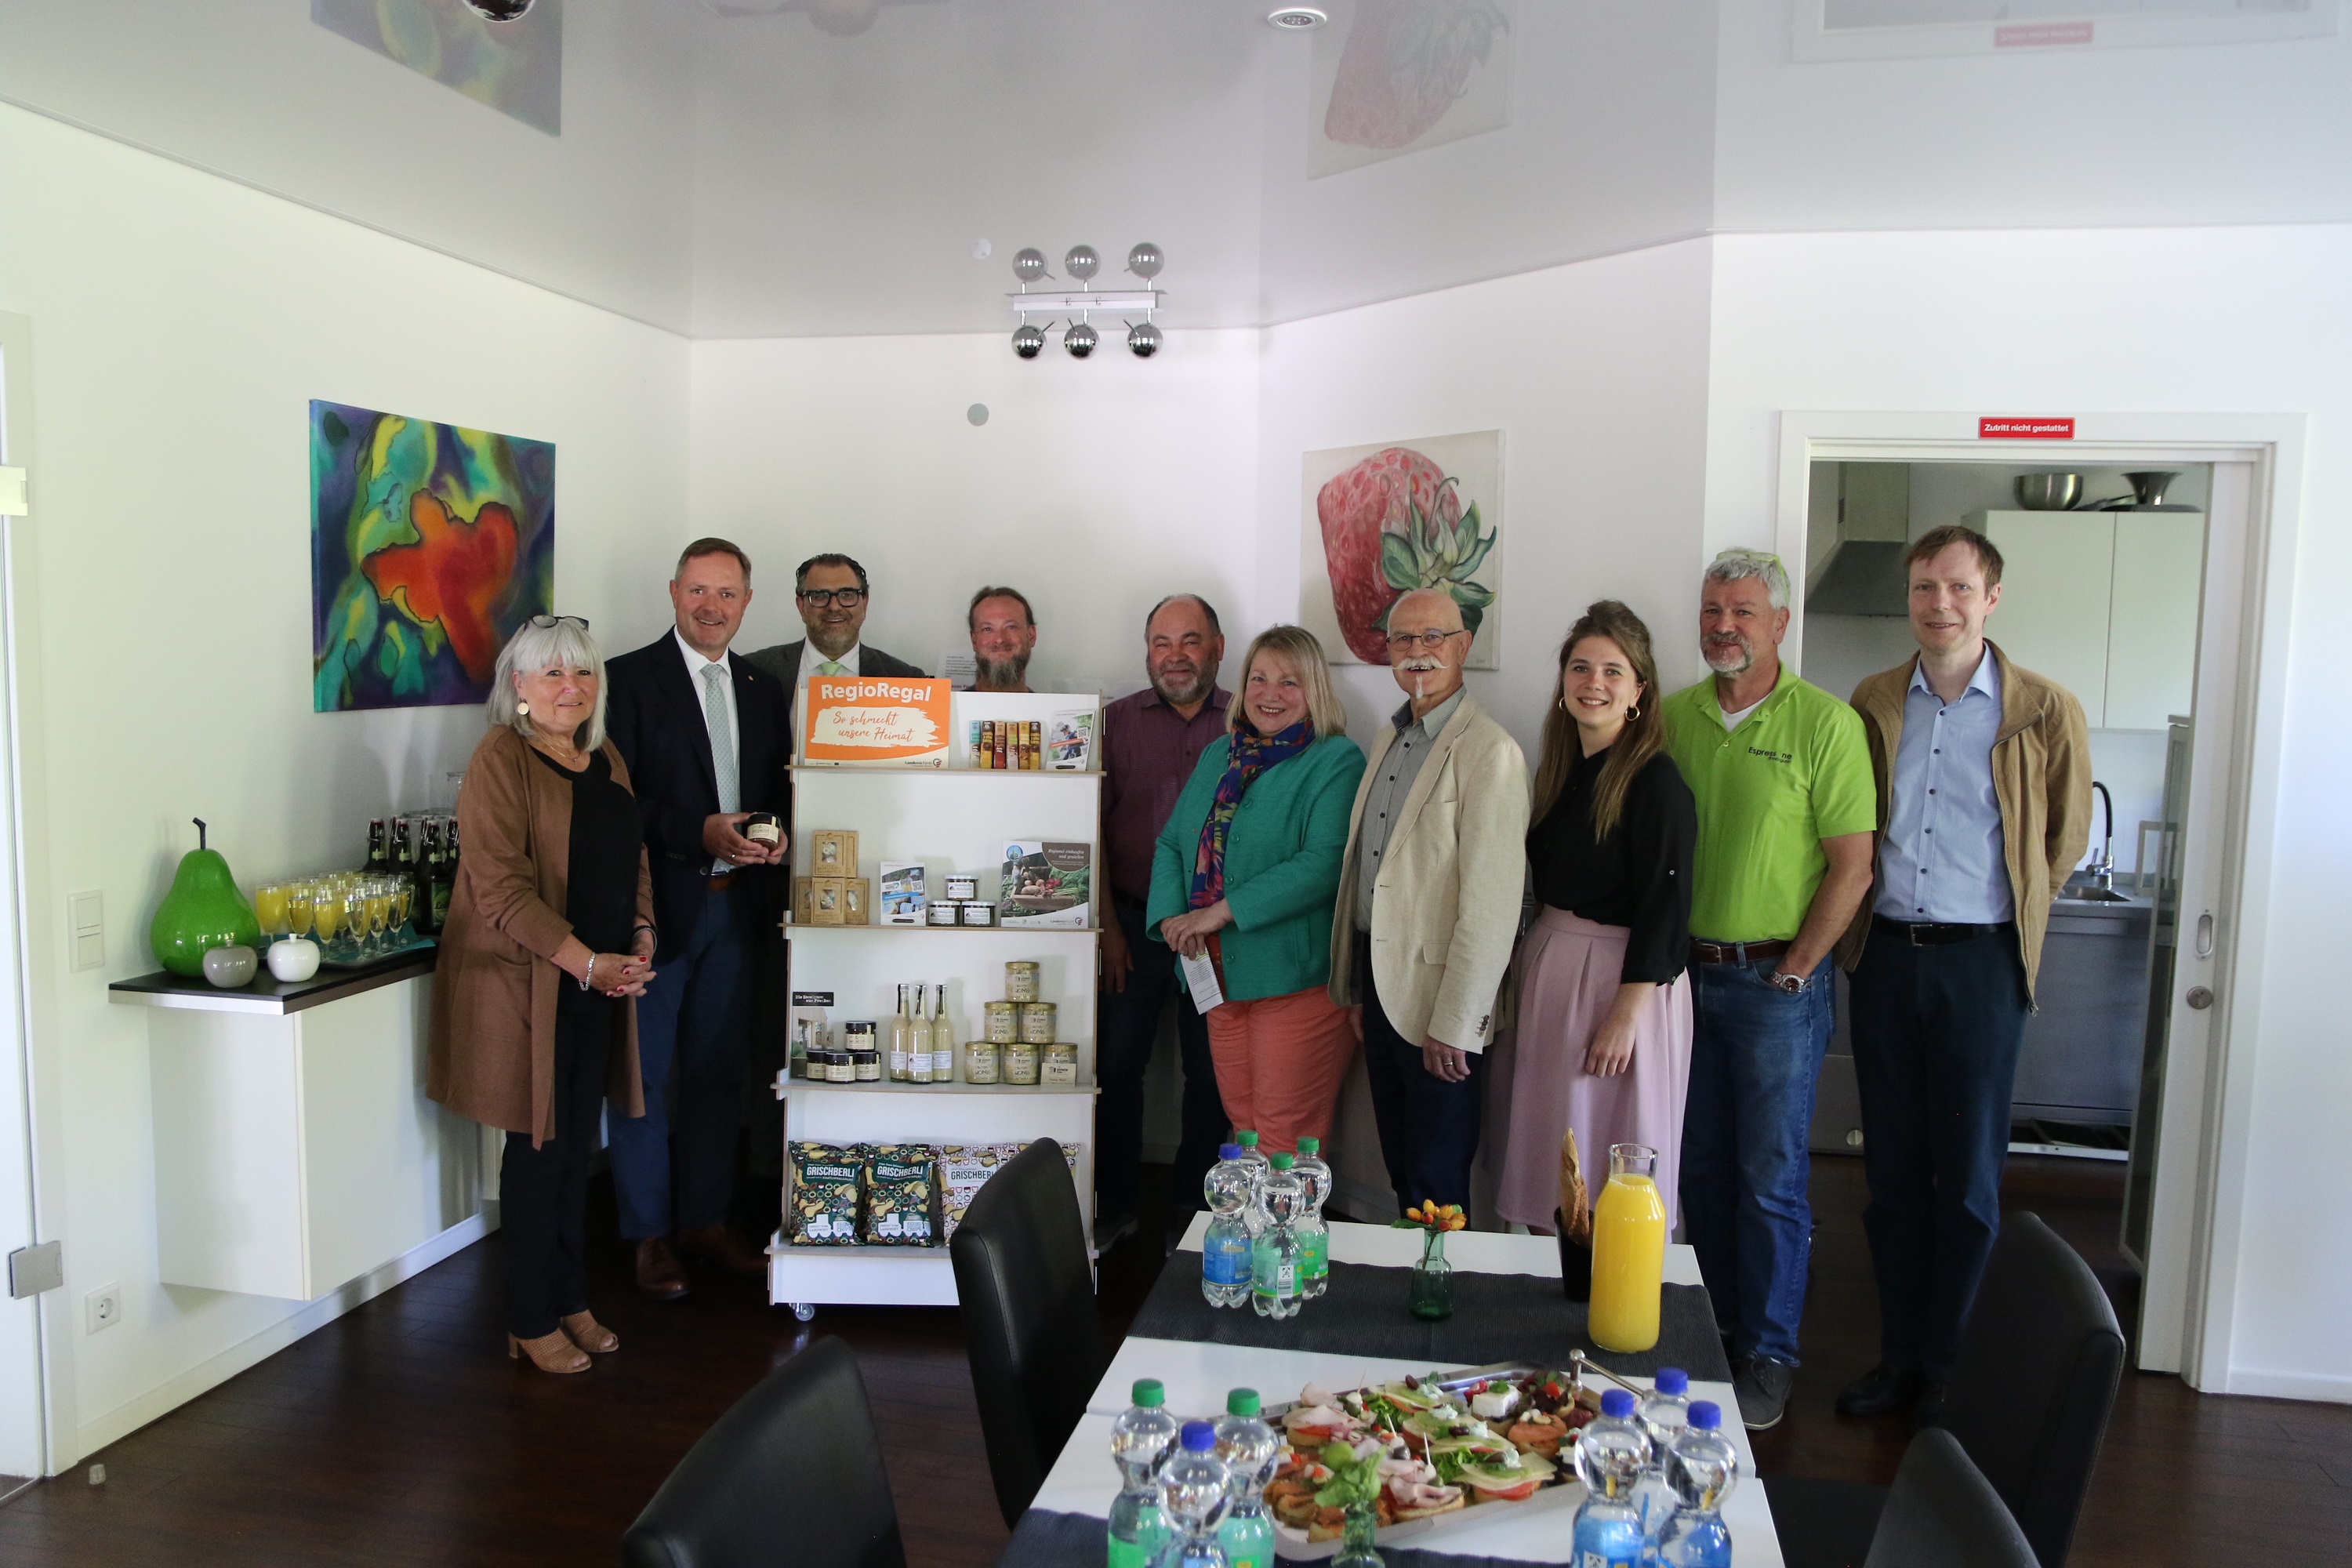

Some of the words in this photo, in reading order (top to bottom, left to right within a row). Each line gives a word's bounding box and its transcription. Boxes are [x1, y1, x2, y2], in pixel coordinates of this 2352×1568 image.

[1984, 423, 2009, 432] Zutritt
[2032, 424, 2069, 434] gestattet
[821, 682, 931, 703] RegioRegal
[833, 711, 846, 724] So
[850, 710, 900, 725] schmeckt
[838, 729, 871, 739] unsere
[873, 727, 915, 742] Heimat
[807, 1166, 855, 1178] GRISCHBERLI
[877, 1166, 924, 1178] GRISCHBERLI
